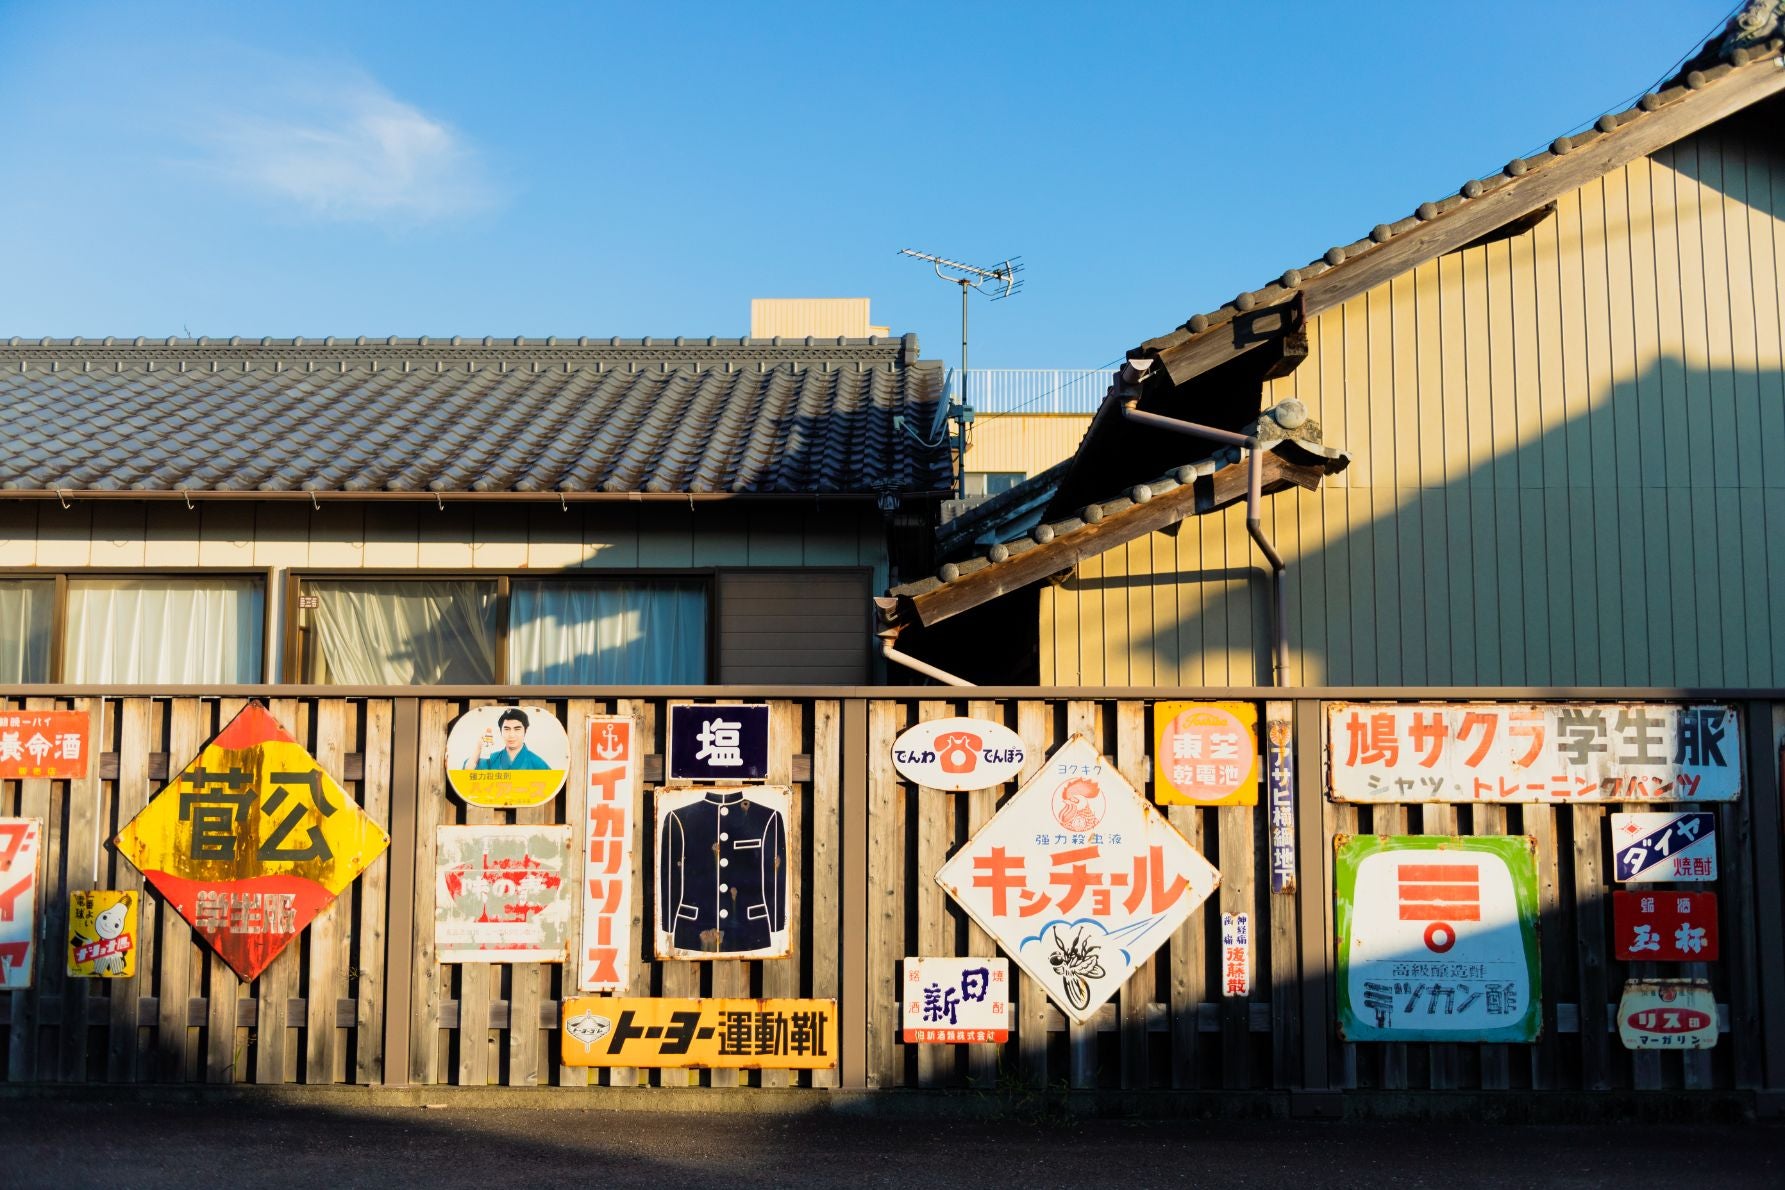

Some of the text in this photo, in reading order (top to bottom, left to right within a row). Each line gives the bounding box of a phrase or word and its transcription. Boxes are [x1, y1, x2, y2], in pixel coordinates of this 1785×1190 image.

[0, 731, 81, 766] 養命酒
[696, 717, 744, 767] 塩
[982, 745, 1024, 763] でんぽう
[1173, 733, 1239, 759] 東芝
[1345, 709, 1728, 767] 鳩サクラ学生服
[894, 750, 936, 764] でんわ
[1058, 764, 1102, 775] ヨクキク
[1173, 764, 1239, 785] 乾電池
[179, 767, 338, 861] 菅公
[1035, 833, 1122, 845] 強力殺虫液
[1622, 817, 1701, 876] ダイヤ
[587, 765, 627, 983] イカリソース
[972, 845, 1188, 918] キンチョール
[1673, 856, 1713, 878] 焼酎
[195, 890, 297, 934] 学生服
[1640, 897, 1692, 914] 銘酒
[1628, 922, 1709, 955] 玉杯
[1226, 947, 1246, 994] 後藤散
[606, 1010, 829, 1057] トーヨー運動靴
[1638, 1012, 1701, 1029] リス印
[1640, 1035, 1701, 1046] マーガリン
